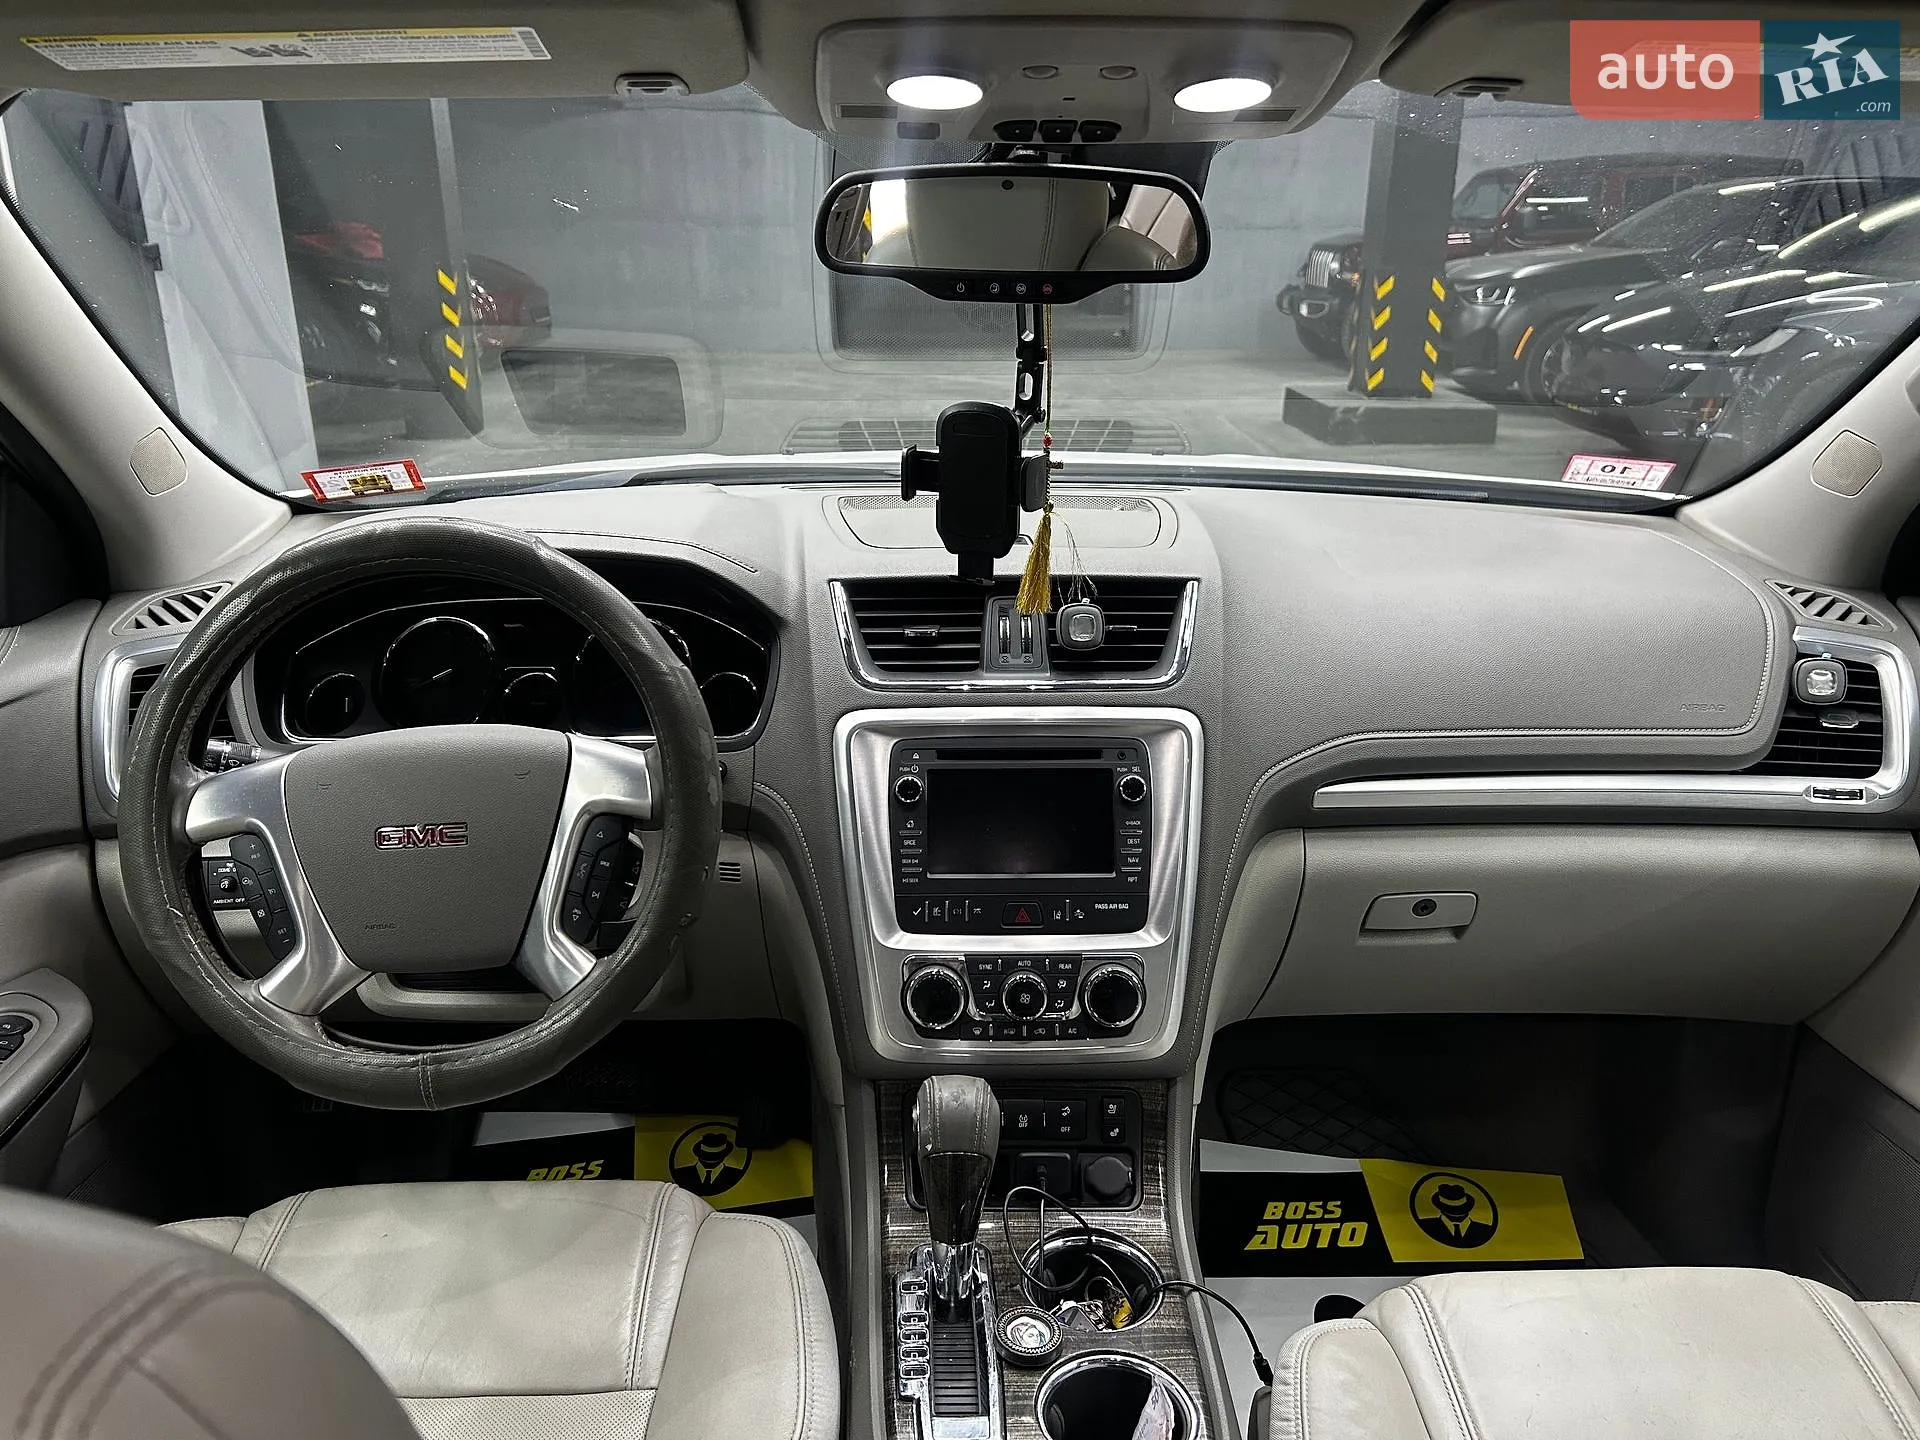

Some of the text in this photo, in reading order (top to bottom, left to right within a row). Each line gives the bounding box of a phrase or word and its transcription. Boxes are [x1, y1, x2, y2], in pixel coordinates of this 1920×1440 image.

[1680, 703, 1726, 712] AIRBAG
[375, 821, 469, 850] GMC
[1263, 1200, 1342, 1220] BOSS
[1243, 1221, 1369, 1250] AUTO
